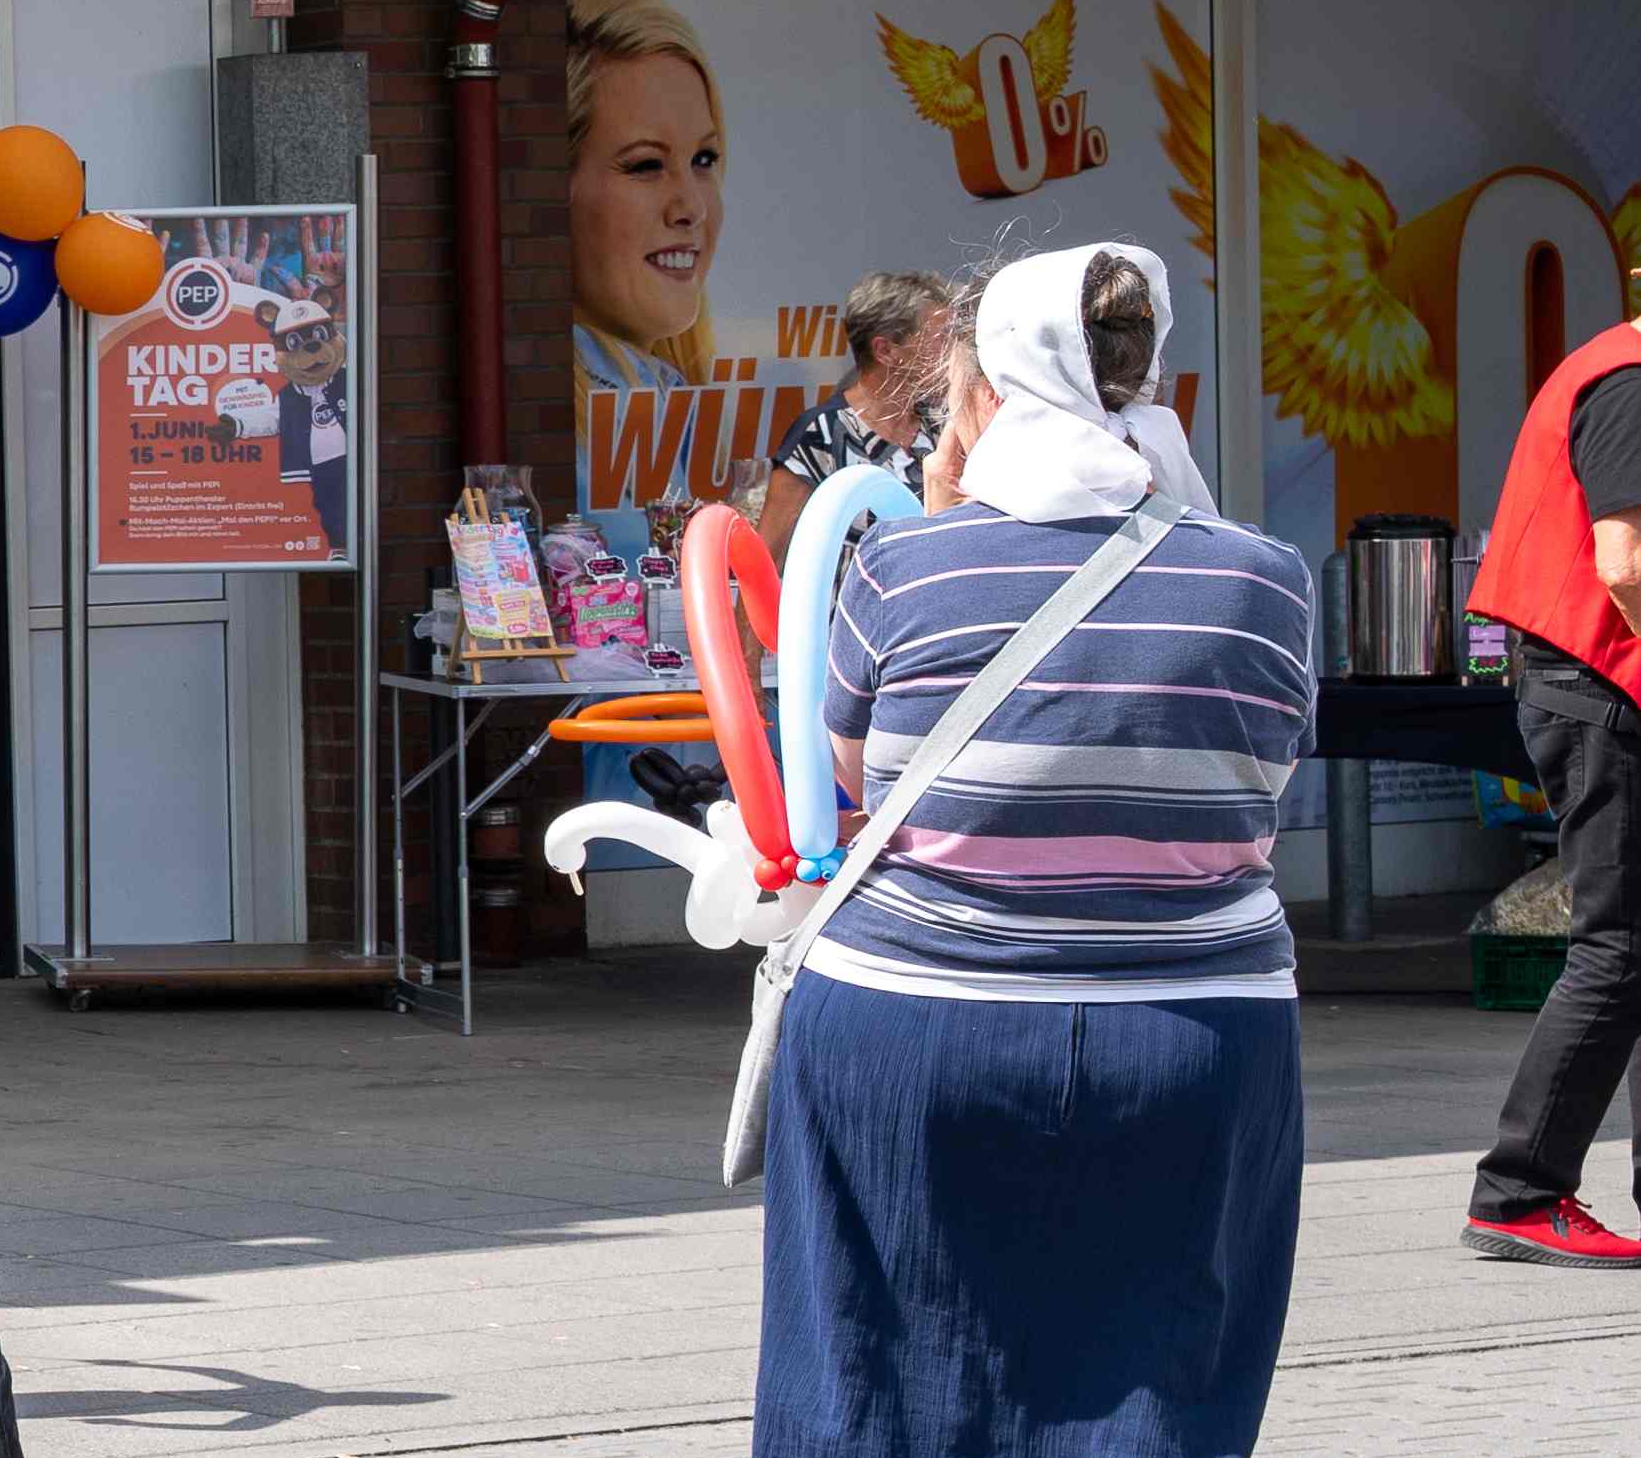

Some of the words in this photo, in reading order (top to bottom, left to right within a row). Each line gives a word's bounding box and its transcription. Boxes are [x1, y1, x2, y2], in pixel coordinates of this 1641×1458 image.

[178, 285, 219, 304] PEP
[127, 343, 279, 376] KINDER
[126, 375, 209, 407] TAG
[129, 445, 154, 464] 15
[181, 445, 204, 463] 18
[211, 444, 262, 463] UHR
